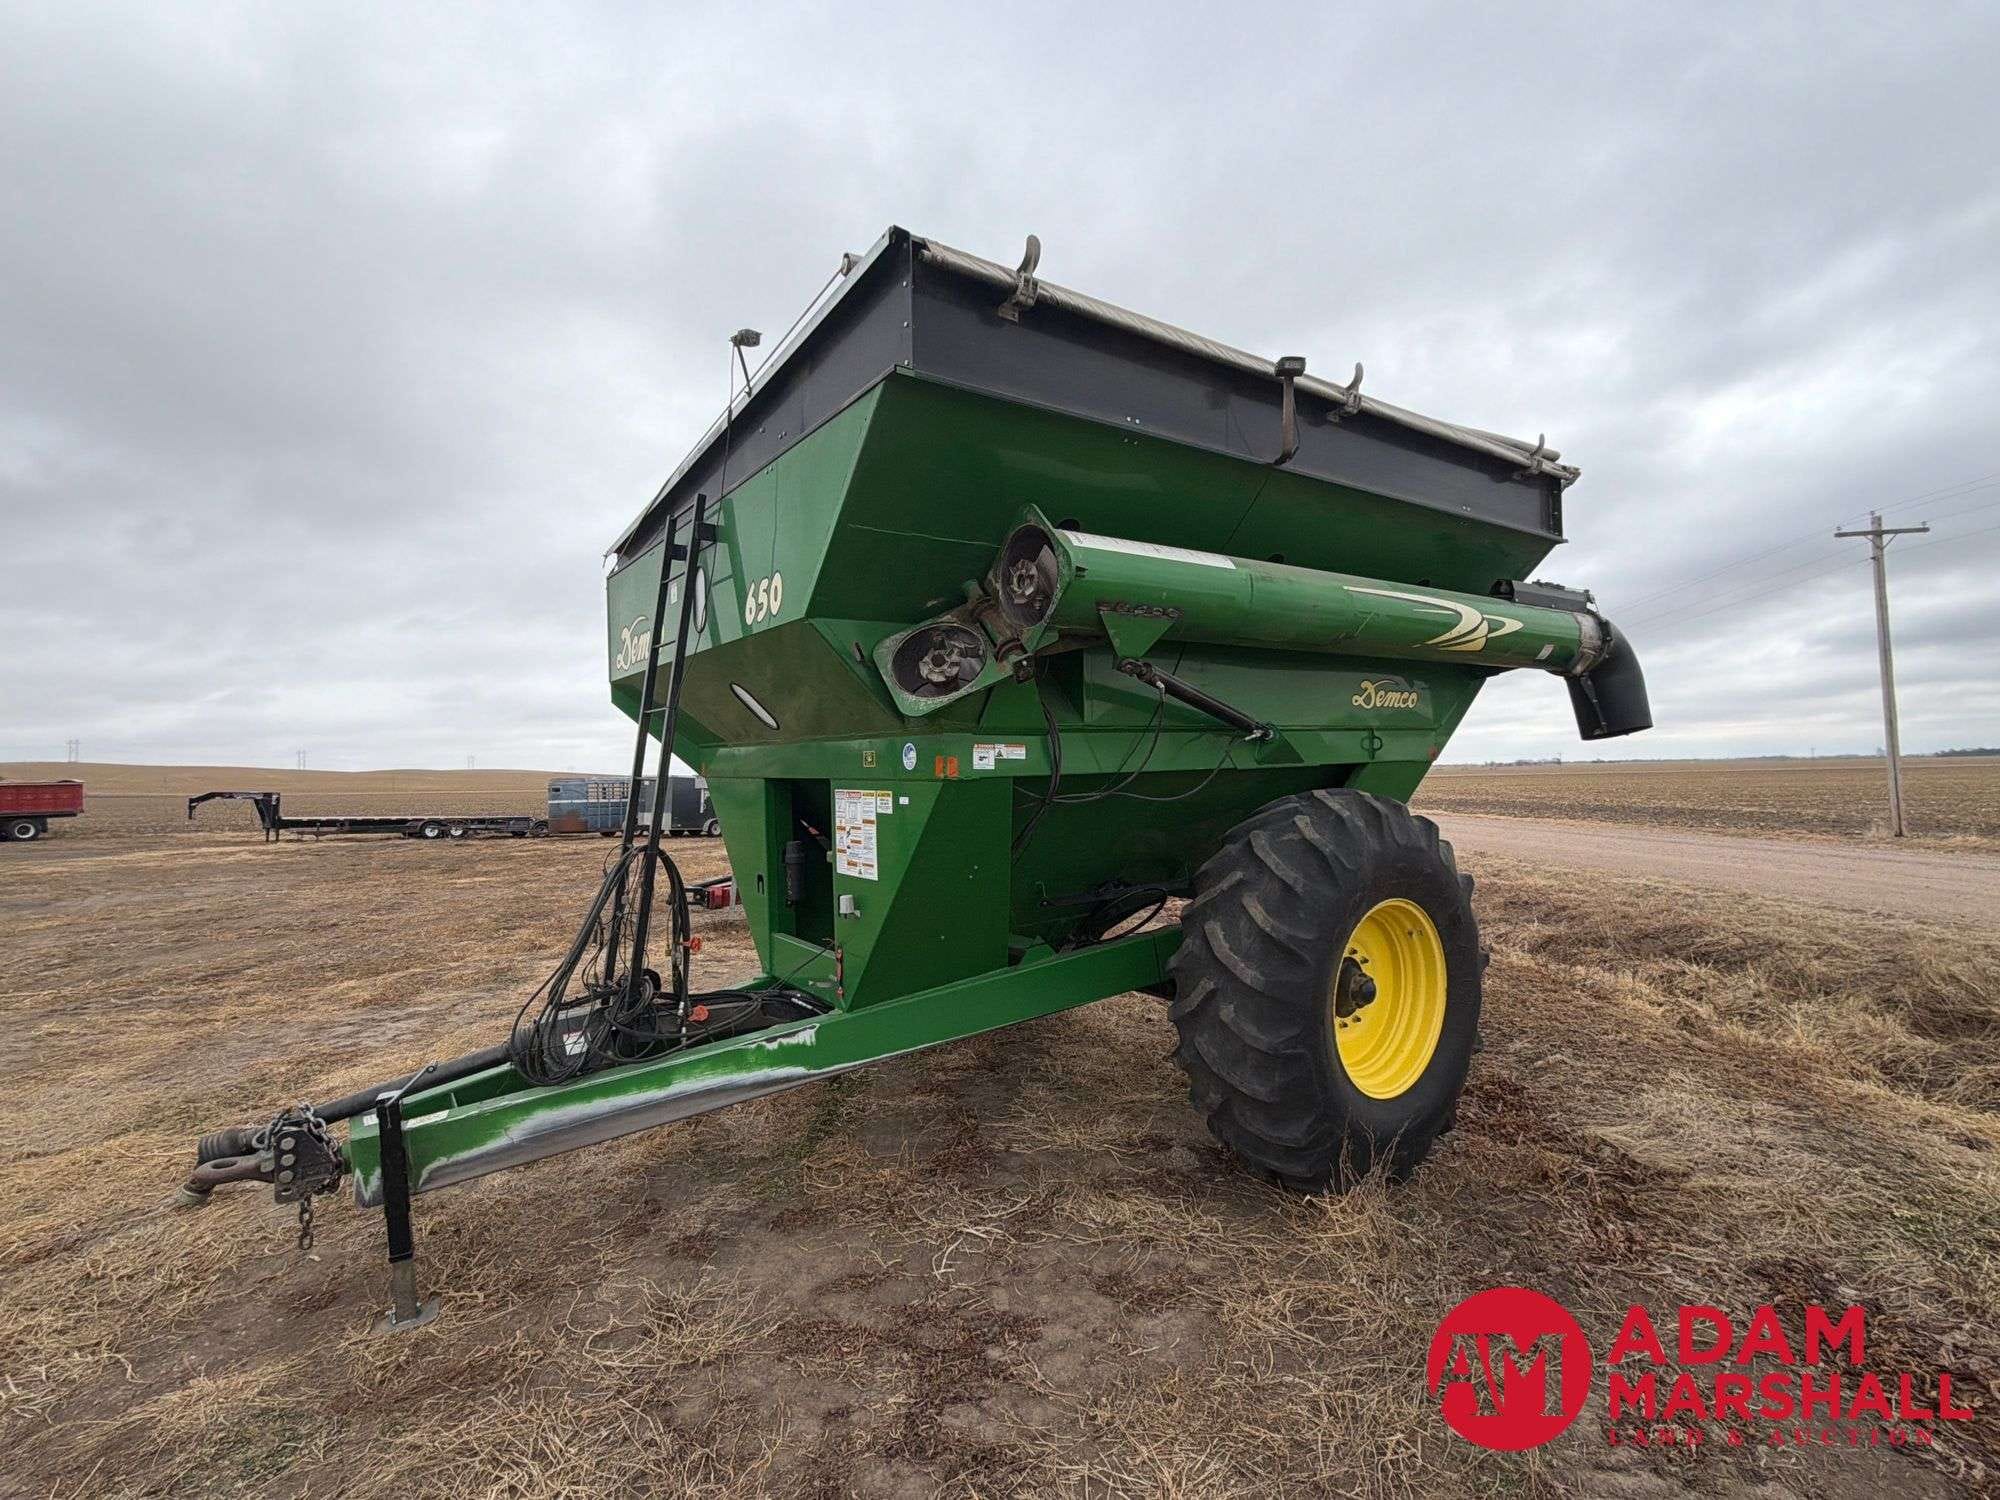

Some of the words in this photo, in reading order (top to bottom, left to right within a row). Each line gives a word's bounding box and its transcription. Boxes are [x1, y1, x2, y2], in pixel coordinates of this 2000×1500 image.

[744, 570, 783, 626] 650
[616, 616, 664, 671] Dem
[1351, 679, 1419, 710] Demco
